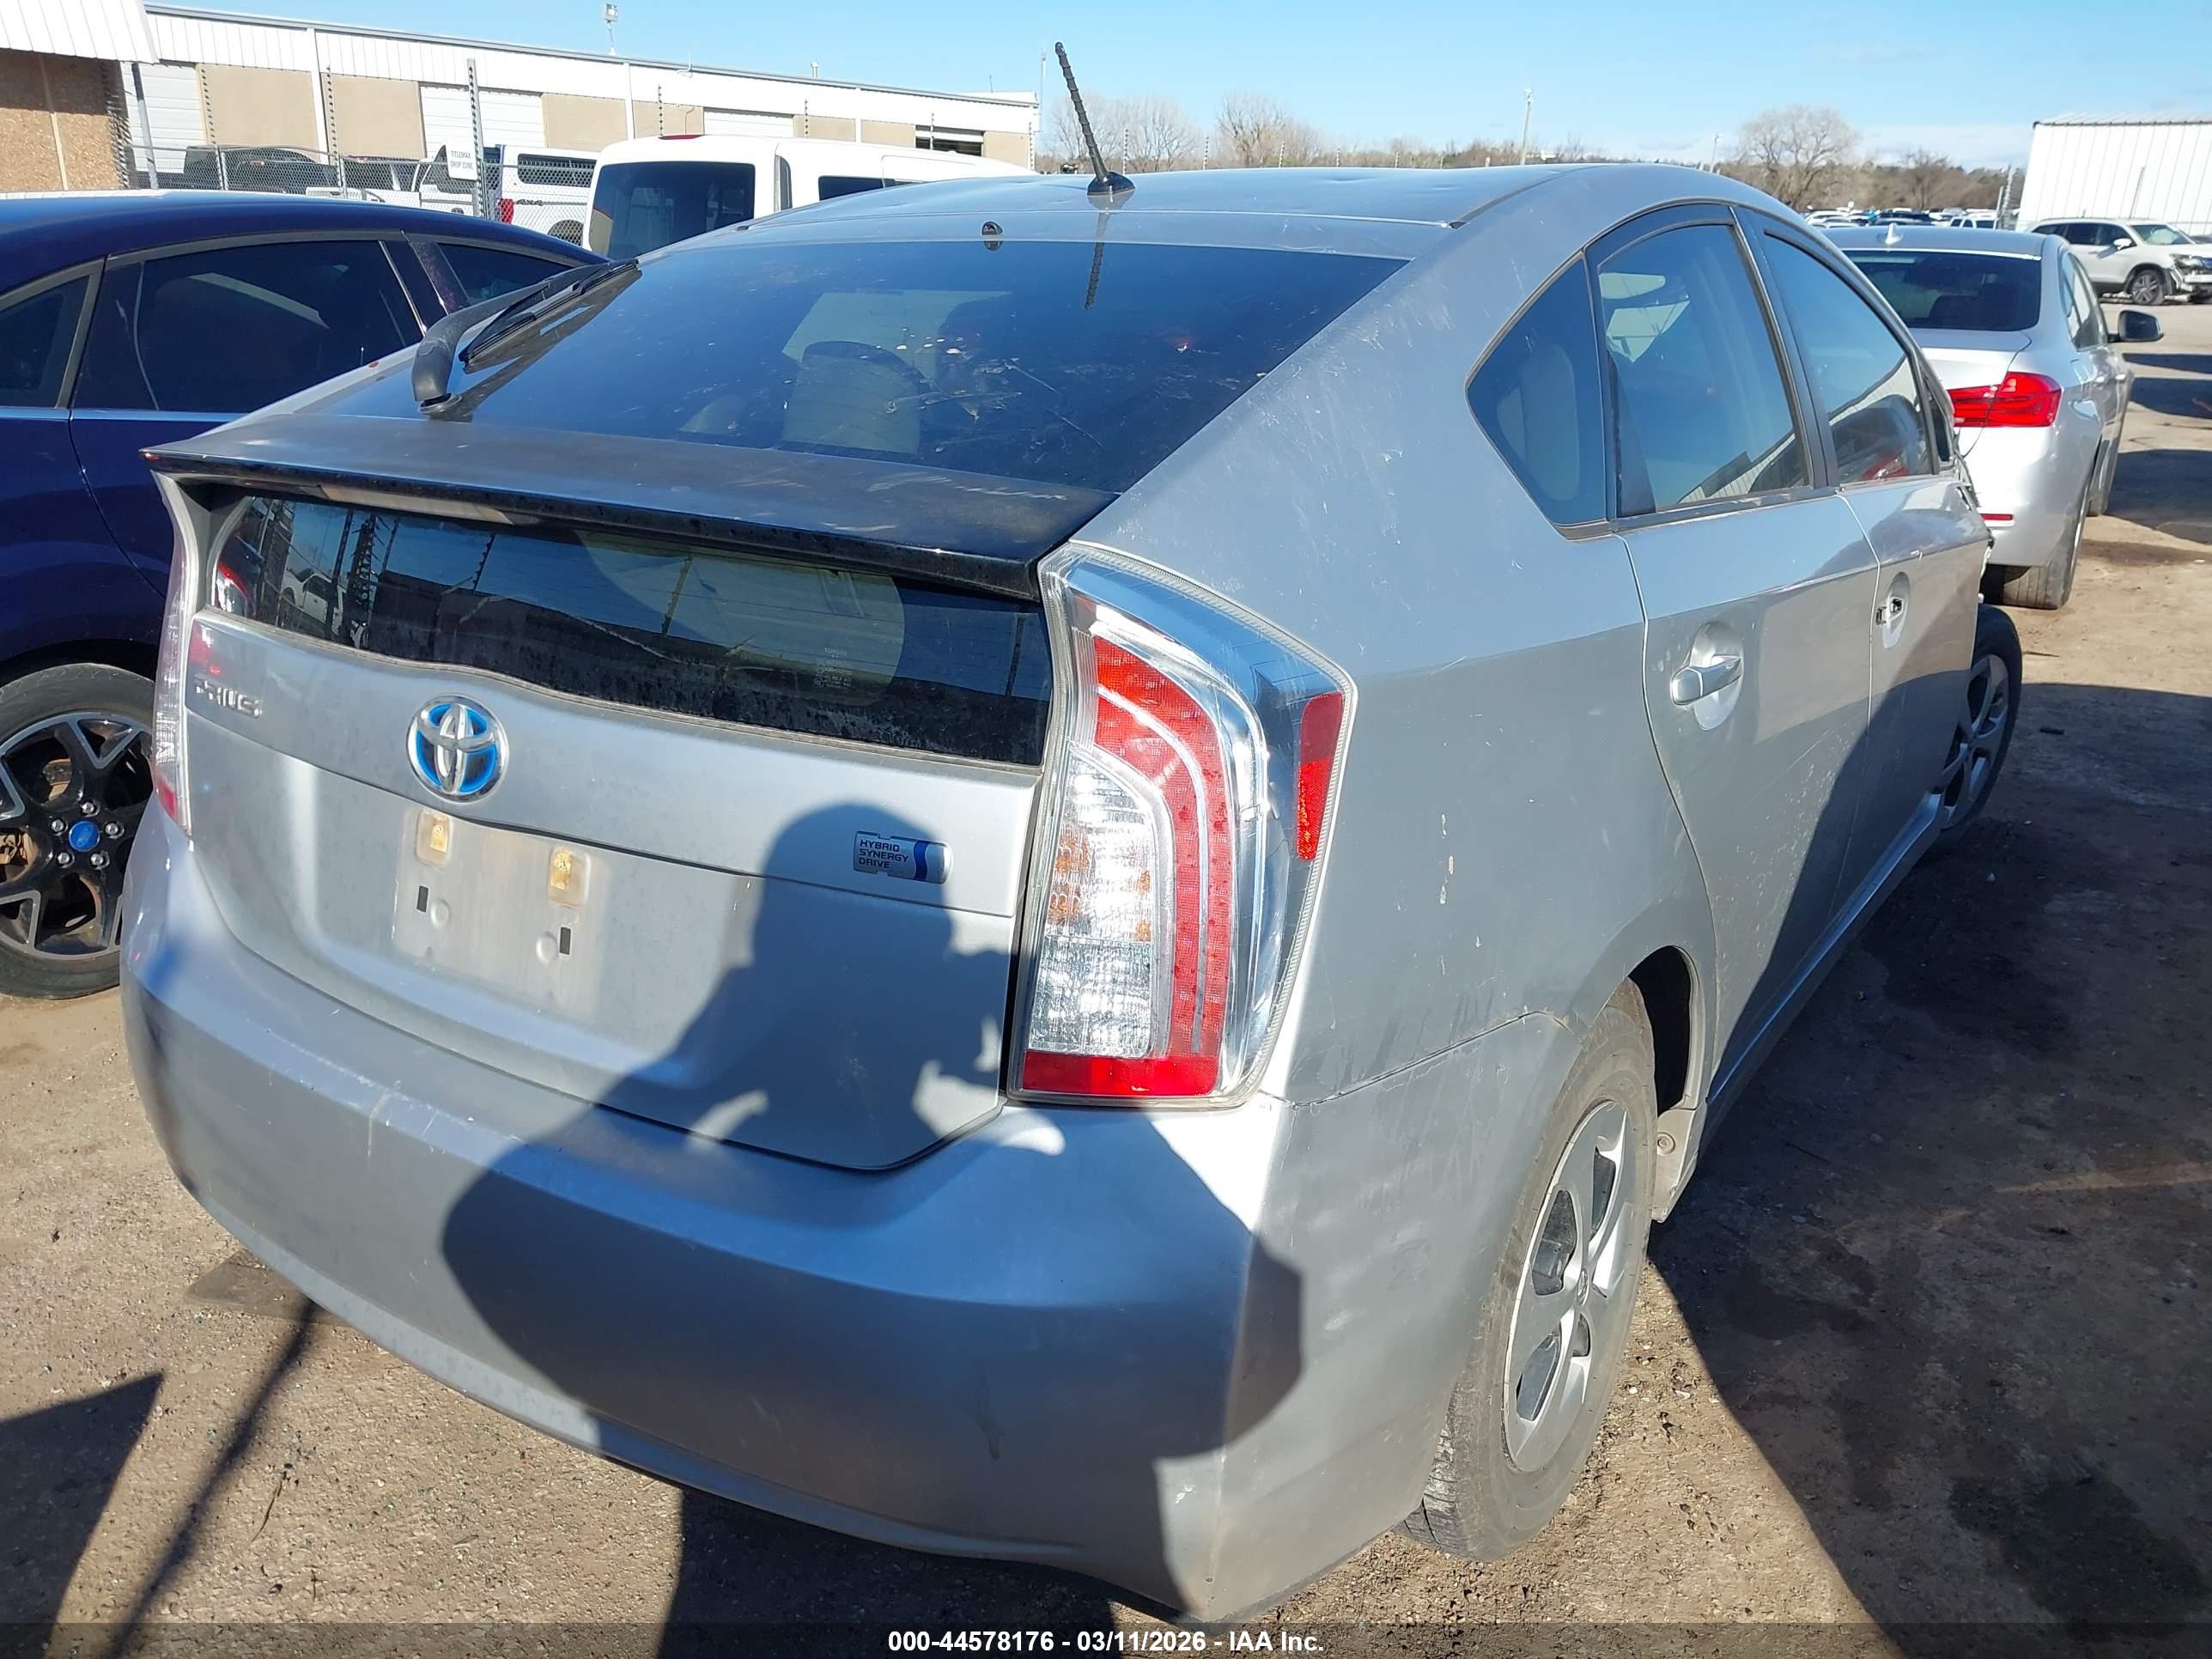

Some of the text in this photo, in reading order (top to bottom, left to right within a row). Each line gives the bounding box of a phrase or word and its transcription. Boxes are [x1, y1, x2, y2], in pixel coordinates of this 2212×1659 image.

[450, 150, 471, 159] TITLEMAX
[462, 161, 474, 170] ZONE
[193, 673, 264, 718] PRIUS
[860, 839, 900, 853] HYBRID
[859, 848, 909, 863] SYNERGY
[858, 857, 891, 869] DRIVE
